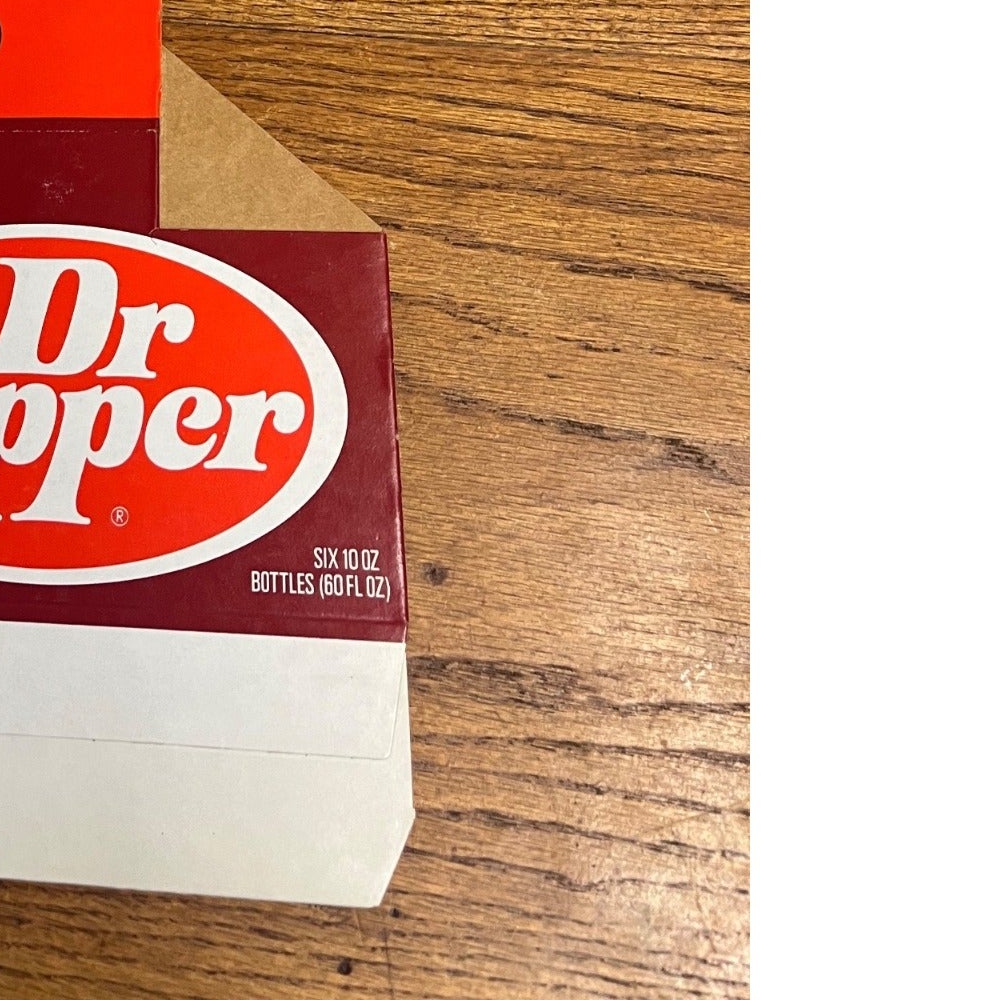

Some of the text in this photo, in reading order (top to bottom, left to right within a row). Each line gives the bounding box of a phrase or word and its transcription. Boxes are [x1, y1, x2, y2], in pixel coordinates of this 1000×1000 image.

[313, 547, 380, 571] SIX 10 OZ
[251, 570, 315, 595] BOTTLES
[366, 575, 391, 603] OZ)
